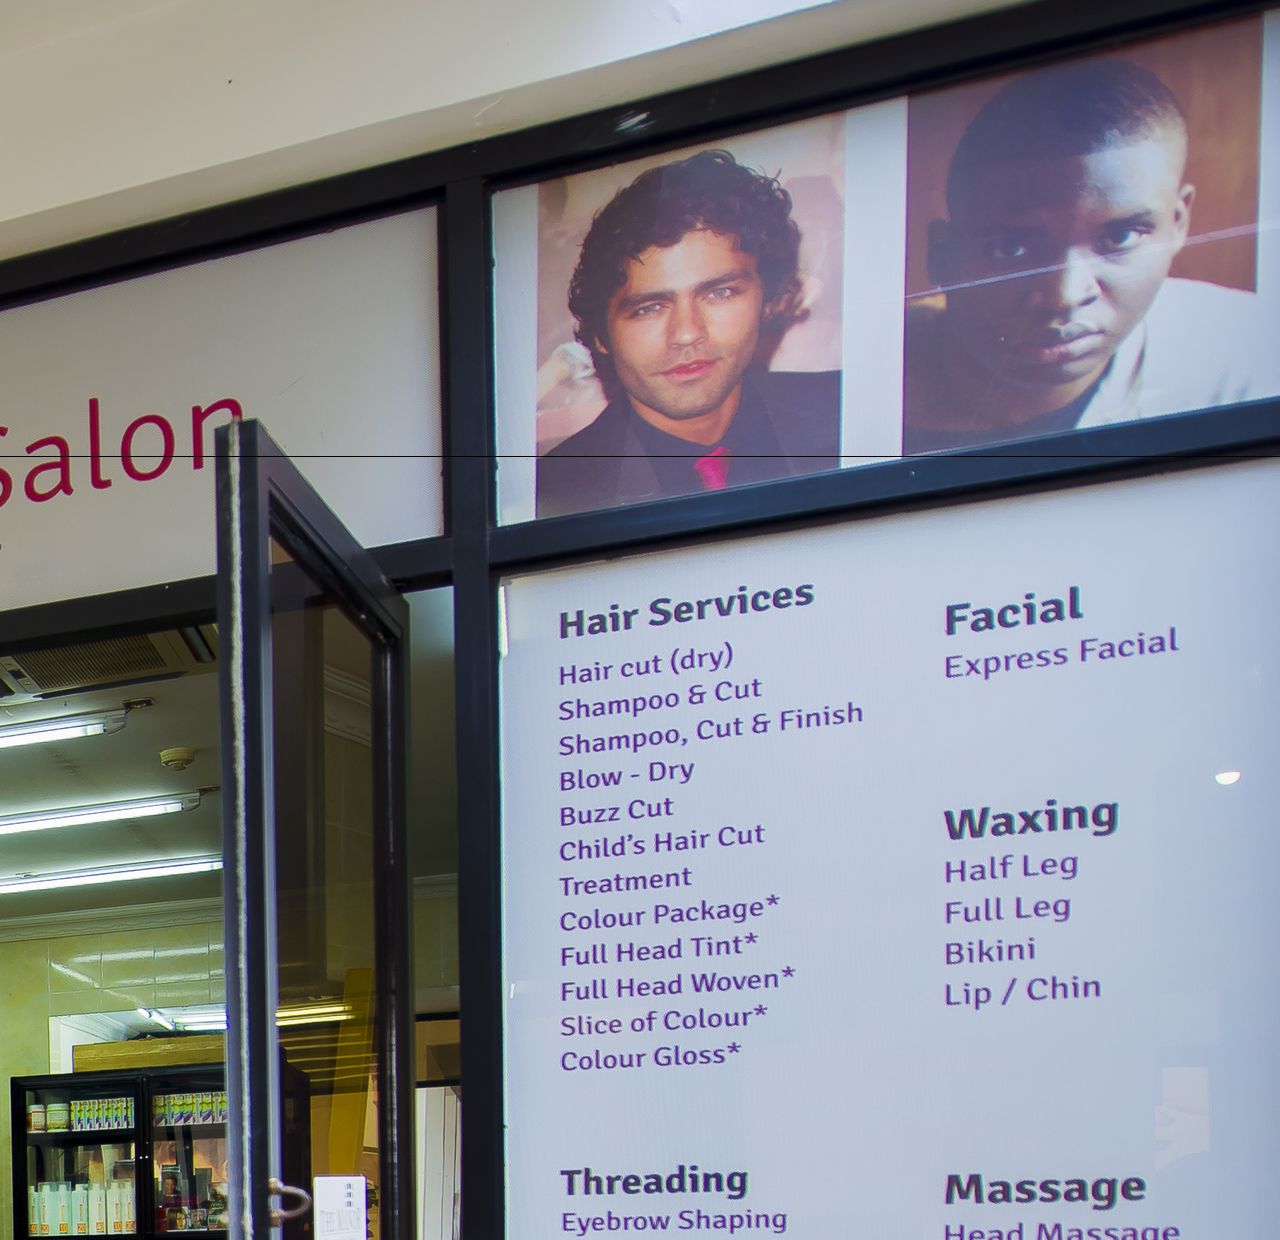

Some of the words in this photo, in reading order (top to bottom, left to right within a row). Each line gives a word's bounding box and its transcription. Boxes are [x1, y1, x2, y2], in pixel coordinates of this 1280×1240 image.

[560, 604, 639, 639] Hair
[648, 584, 814, 626] Services
[944, 586, 1083, 636] Facial
[560, 662, 613, 685] Hair
[620, 655, 662, 677] cut
[670, 641, 733, 675] (dry)
[945, 648, 1068, 680] Express
[1080, 627, 1179, 662] Facial
[559, 693, 679, 721] Shampoo
[688, 685, 707, 705] &
[715, 679, 762, 702] Cut
[559, 729, 688, 756] Shampoo,
[696, 718, 744, 740] Cut
[752, 713, 771, 734] &
[780, 702, 862, 731] Finish
[560, 769, 622, 791] Blow
[649, 762, 695, 784] Dry
[560, 807, 620, 826] Buzz
[627, 798, 674, 819] Cut
[944, 799, 1118, 840] Waxing
[654, 830, 711, 853] Hair
[717, 825, 765, 847] Cut
[559, 867, 692, 896] Treatment
[945, 854, 1014, 883] Half
[1023, 855, 1078, 880] Leg
[560, 909, 646, 931] Colour
[945, 896, 1004, 924] Full
[1015, 896, 1070, 923] Leg
[561, 943, 608, 966] Full
[616, 938, 682, 962] Head
[945, 937, 1035, 965] Bikini
[561, 979, 608, 1001] Full
[616, 973, 682, 998] Head
[945, 983, 991, 1010] Lip
[1002, 977, 1017, 1006] /
[1027, 976, 1101, 1001] Chin
[560, 1015, 622, 1036] Slice
[631, 1011, 658, 1033] of
[560, 1049, 647, 1071] Colour
[560, 1164, 748, 1200] Threading
[944, 1173, 1146, 1211] Massage
[562, 1210, 670, 1237] Eyebrow
[678, 1209, 787, 1234] Shaping
